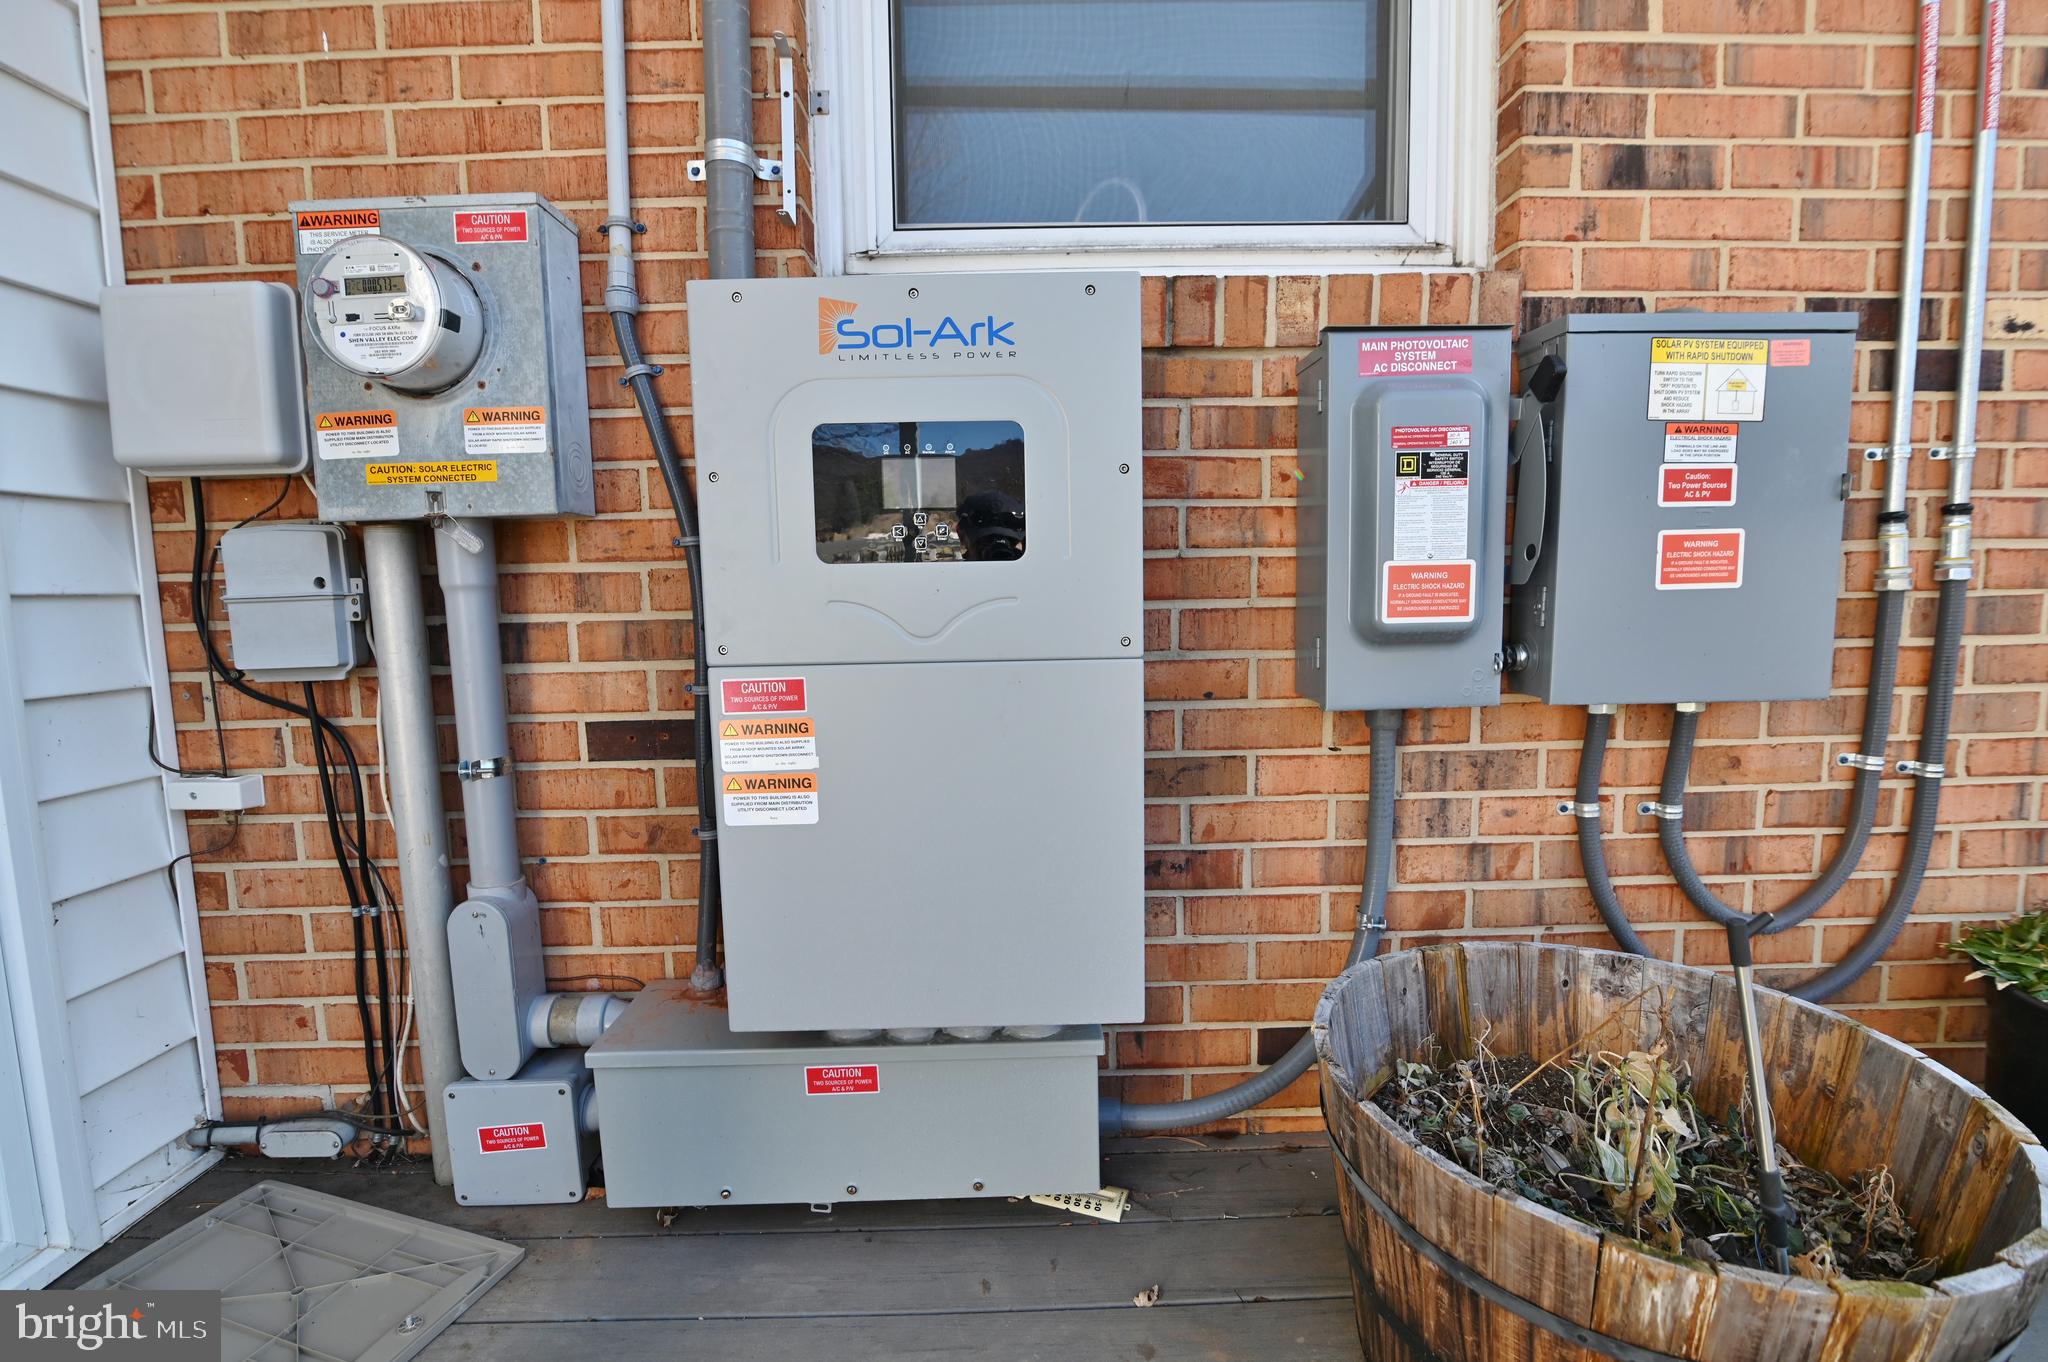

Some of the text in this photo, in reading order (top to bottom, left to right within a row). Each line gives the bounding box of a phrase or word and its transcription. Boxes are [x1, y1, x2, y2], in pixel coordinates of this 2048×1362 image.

[310, 213, 377, 226] WARNING
[471, 215, 510, 225] CAUTION
[837, 315, 1015, 349] Sol-Ark
[1362, 339, 1468, 351] MAIN PHOTOVOLTAIC
[1656, 340, 1764, 349] SOLAR PV SYSTEM EQUIPPED
[839, 351, 1016, 361] LIMITLESS POWER
[1395, 351, 1436, 360] SYSTEM
[1666, 352, 1753, 360] WITH RAPID SHUTDOWN
[1374, 361, 1457, 373] AC DISCONNECT
[334, 414, 392, 426] WARNING
[482, 411, 540, 421] WARNING
[1684, 426, 1729, 434] WARNING
[370, 464, 492, 474] CAUTION: SOLAR ELECTRIC
[387, 474, 477, 484] SYSTEM CONNECTED
[741, 682, 786, 694] CAUTION
[741, 722, 809, 735] WARNING
[744, 777, 812, 789] WARNING
[822, 1068, 861, 1078] CAUTION
[493, 1127, 529, 1137] CAUTION
